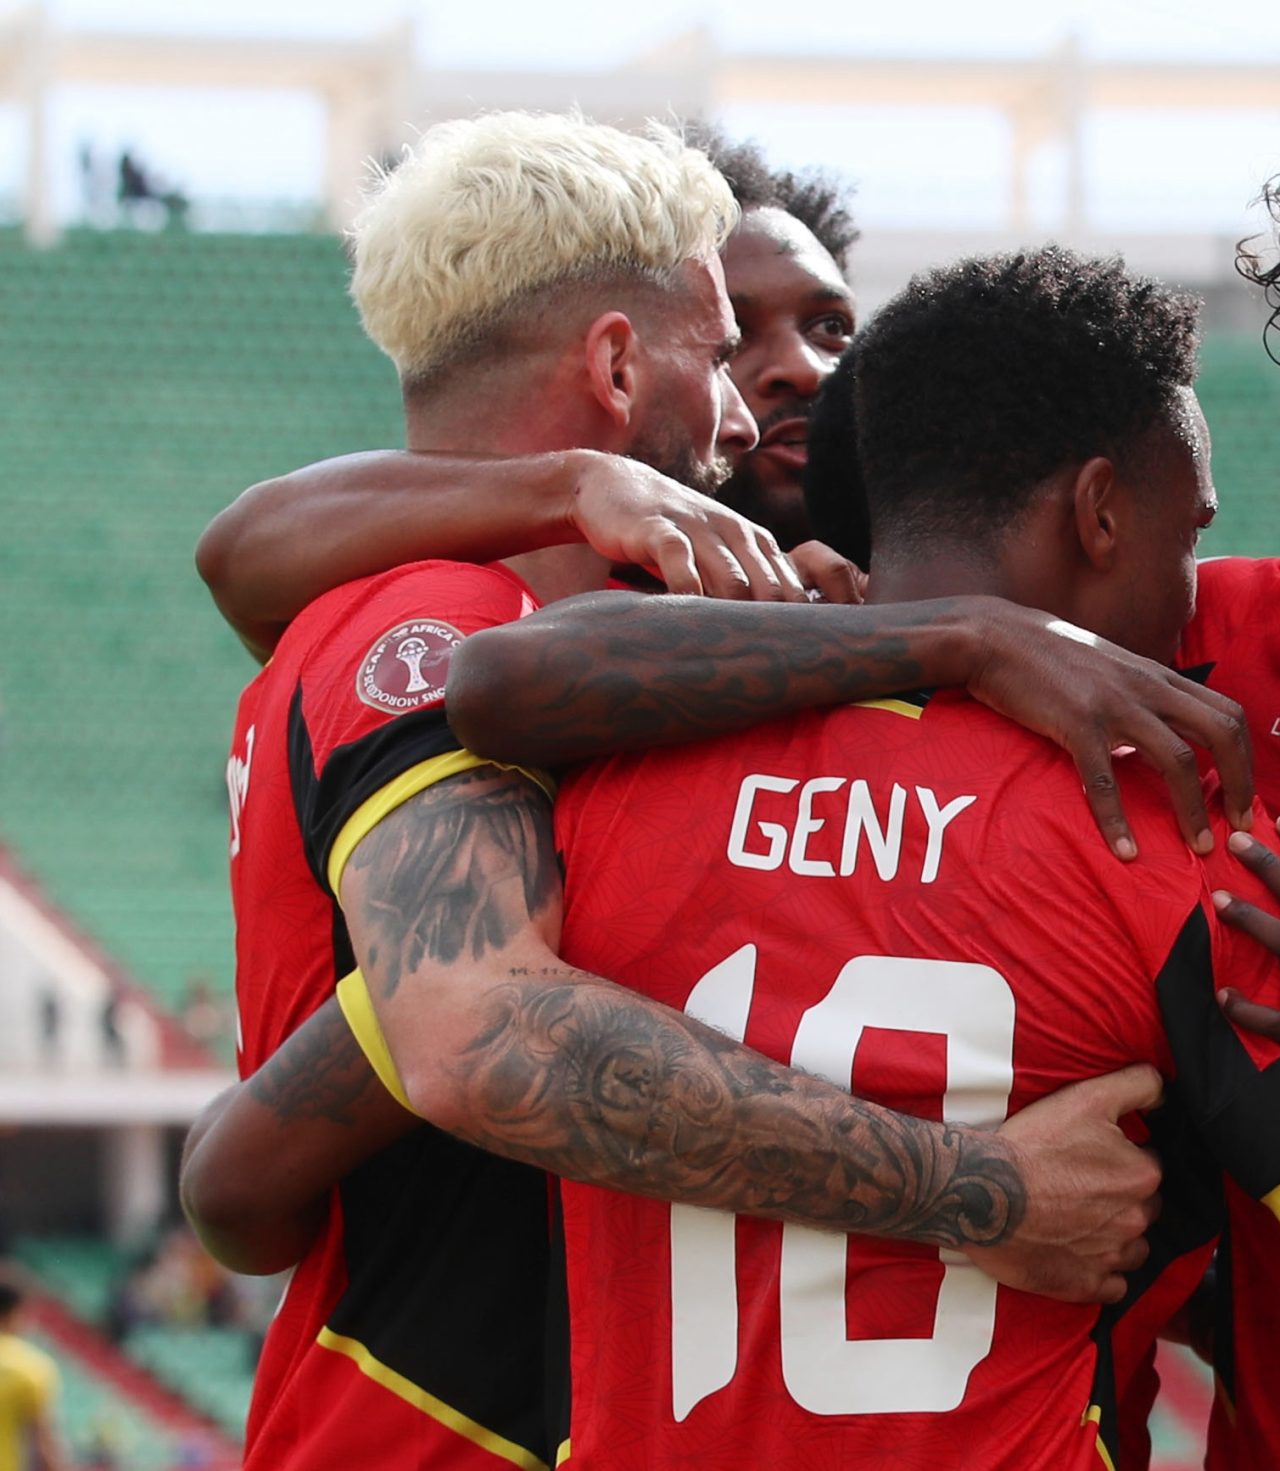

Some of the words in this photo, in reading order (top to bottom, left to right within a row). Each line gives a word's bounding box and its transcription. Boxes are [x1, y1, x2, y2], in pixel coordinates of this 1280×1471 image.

[410, 624, 453, 642] AFRICA
[726, 774, 977, 883] GENY
[670, 944, 1016, 1423] 10
